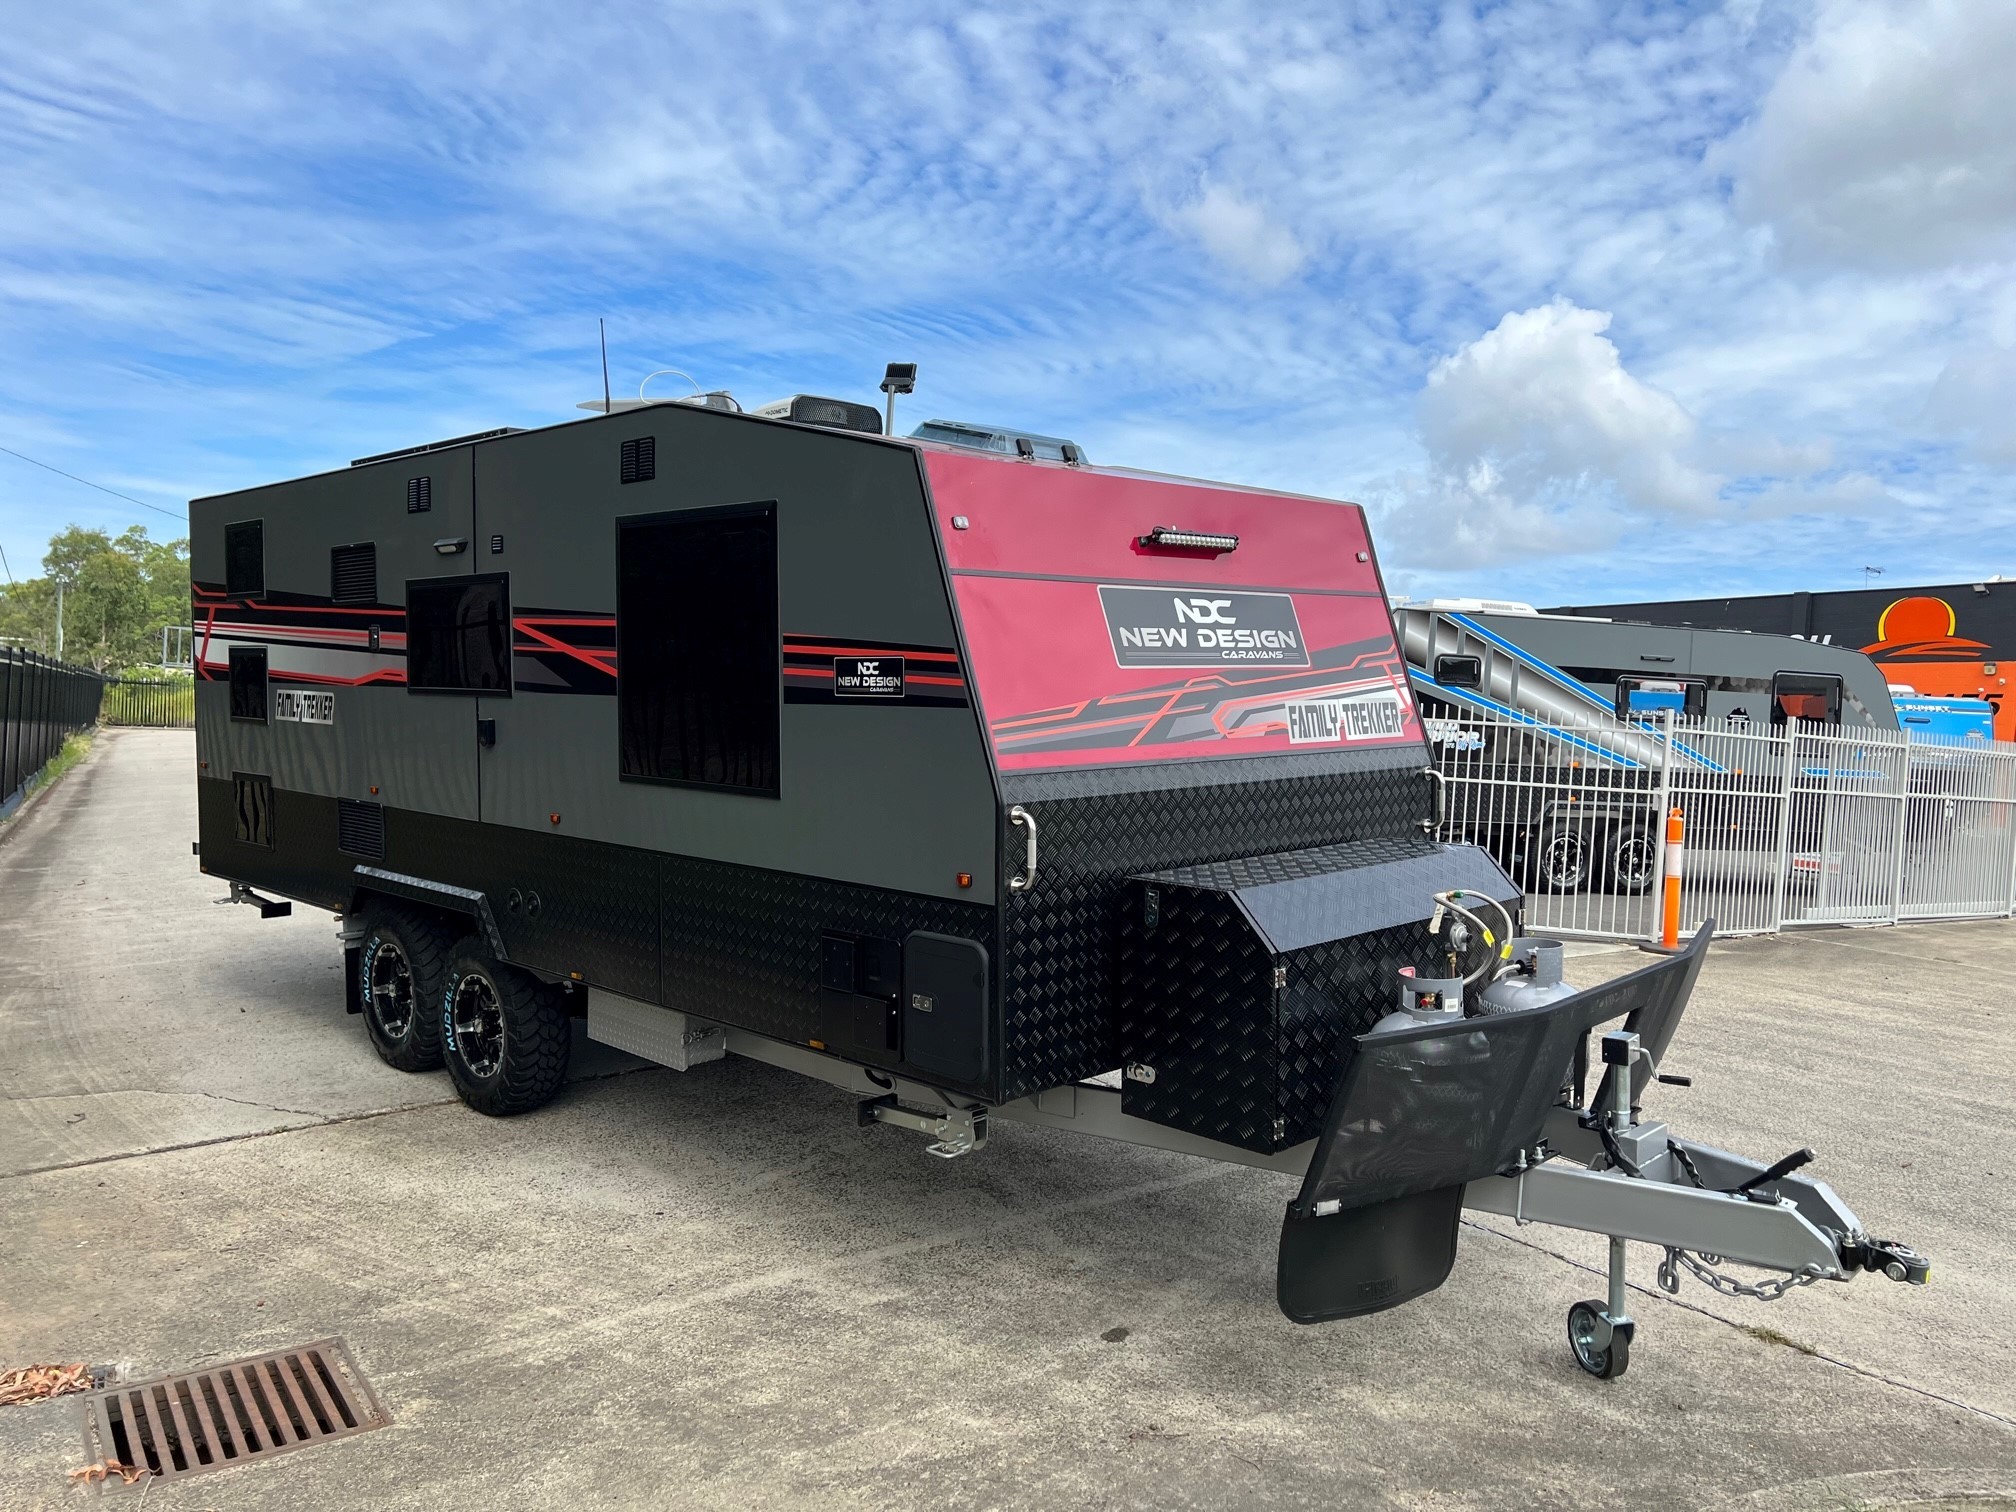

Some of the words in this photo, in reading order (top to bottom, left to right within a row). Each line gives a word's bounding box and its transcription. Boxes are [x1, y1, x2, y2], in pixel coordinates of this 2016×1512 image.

[1173, 597, 1237, 625] NDC
[1119, 626, 1188, 648] NEW
[1196, 627, 1298, 649] DESIGN
[1221, 650, 1285, 659] CARAVANS
[857, 661, 880, 675] NDC
[838, 676, 861, 687] NEW
[862, 676, 901, 687] DESIGN
[276, 692, 301, 719] FAMILY
[303, 693, 334, 721] TREKKER
[1905, 704, 1951, 713] SUNSET
[1288, 703, 1339, 739] FAMILY
[1342, 701, 1402, 736] TREKKER
[363, 936, 381, 1003] MUDZILLA
[444, 972, 460, 1051] MUDZILLA
